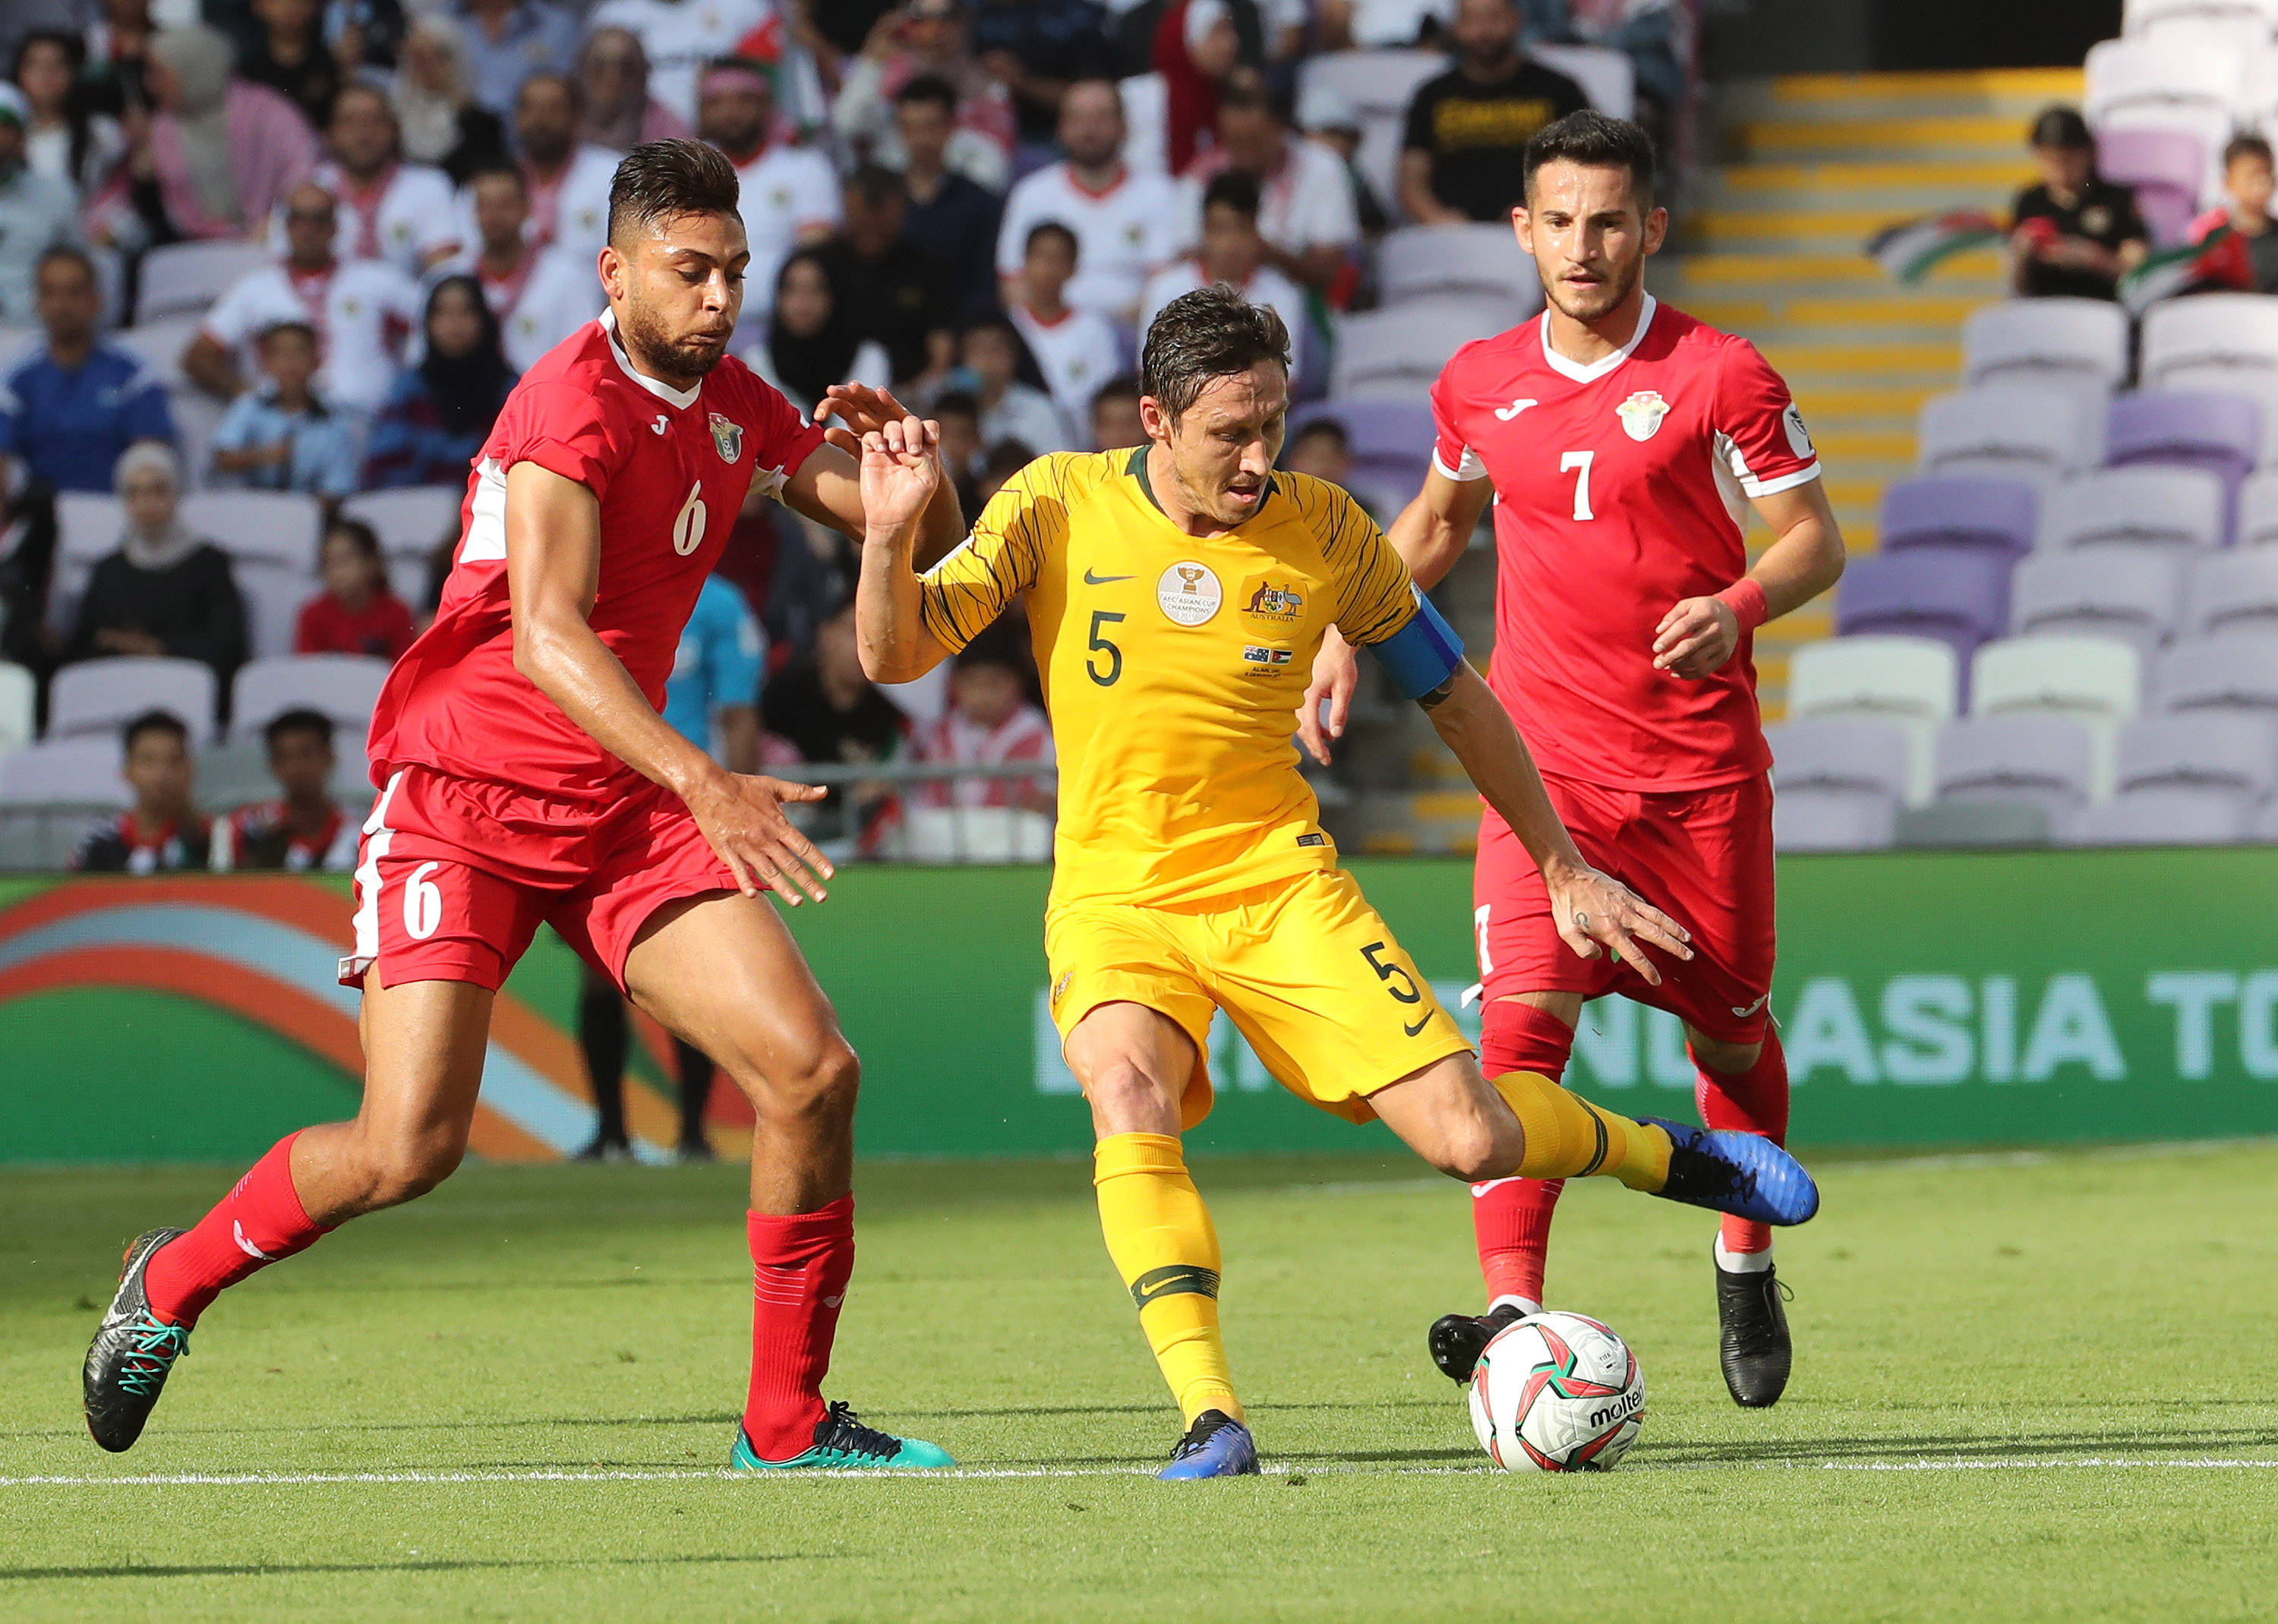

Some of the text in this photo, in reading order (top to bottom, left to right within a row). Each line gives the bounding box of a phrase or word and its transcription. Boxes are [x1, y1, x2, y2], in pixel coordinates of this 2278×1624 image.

[674, 480, 706, 556] 6
[1560, 450, 1595, 521] 7
[1166, 604, 1210, 614] CHAMPIONS
[1178, 598, 1201, 606] ASIAN
[1251, 613, 1295, 623] AUSTRALIA
[1086, 610, 1126, 686] 5
[403, 861, 443, 940] 6
[1359, 941, 1421, 1004] 5
[1786, 973, 2126, 1086] ASIA
[1590, 1385, 1644, 1428] molten
